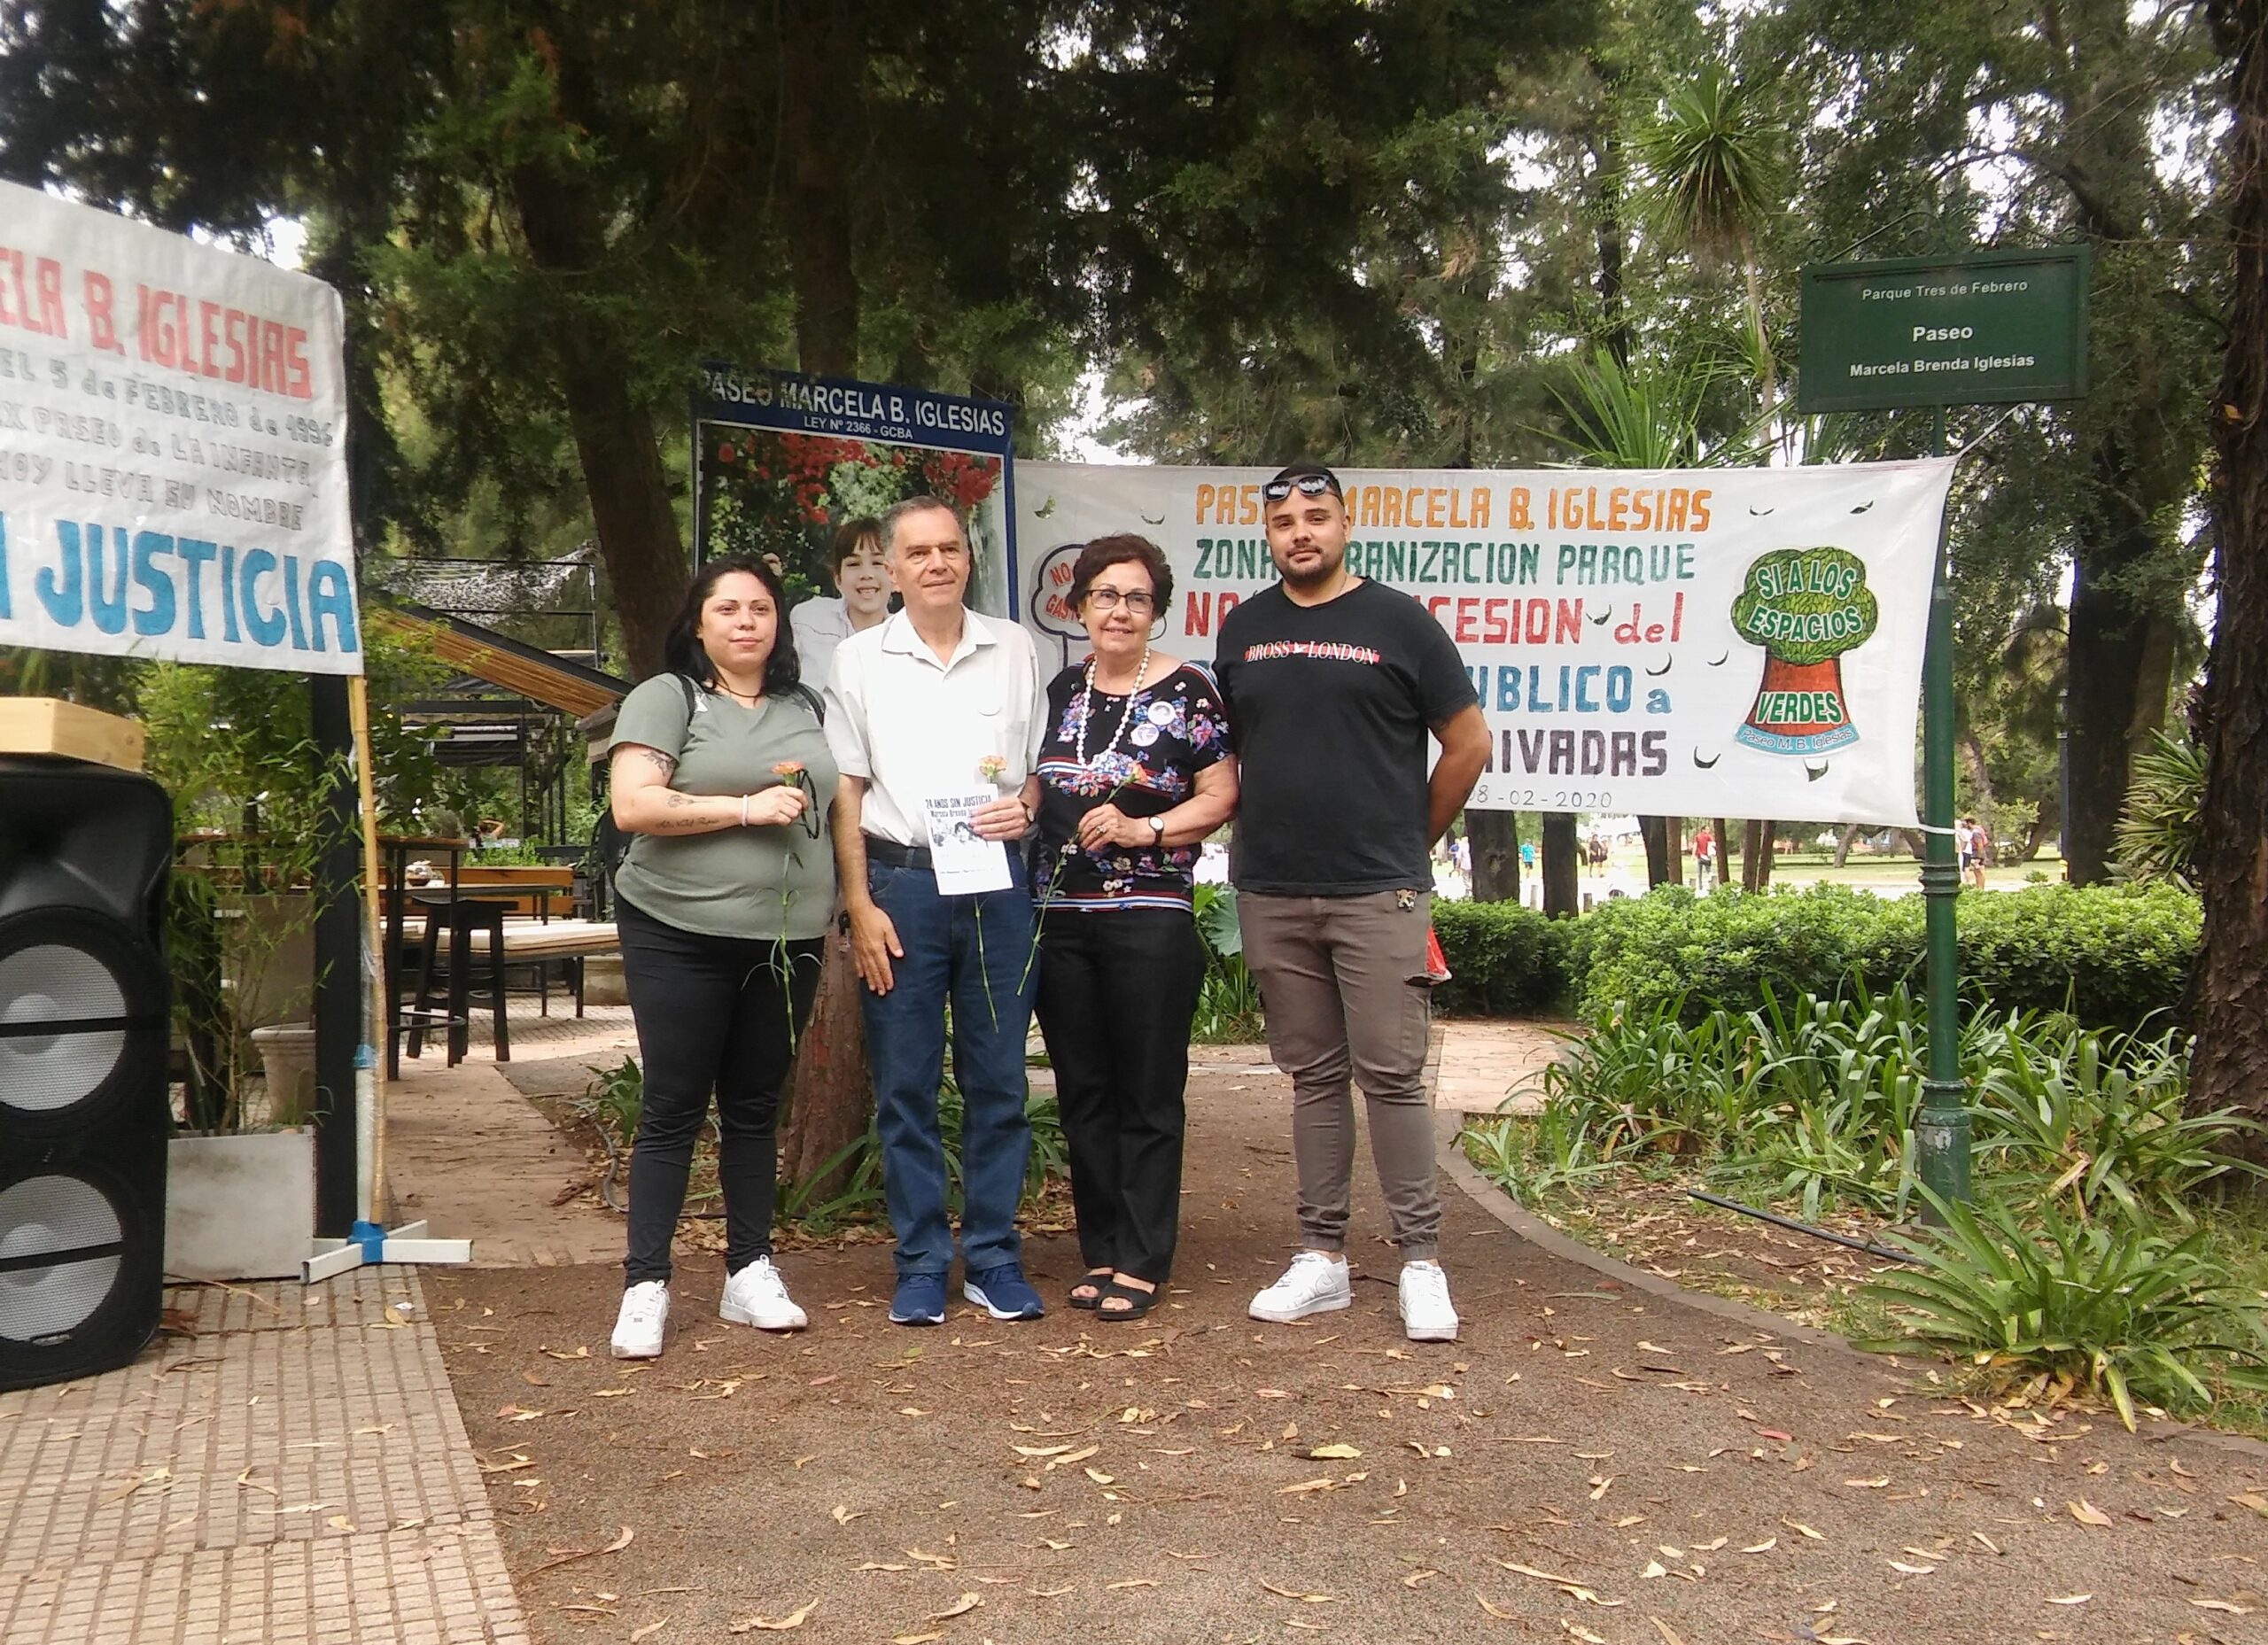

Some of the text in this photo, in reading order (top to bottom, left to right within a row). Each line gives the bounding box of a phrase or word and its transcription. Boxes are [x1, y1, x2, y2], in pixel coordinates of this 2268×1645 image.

[1862, 280, 2028, 301] Parque Tres de Febrero
[138, 283, 313, 400] IGLESIAS
[1912, 326, 1974, 342] Paseo
[1850, 353, 2035, 377] Marcela Brenda Iglesias
[123, 377, 238, 428] FEBRERO
[780, 382, 885, 421] MARCELA
[890, 396, 910, 424] B.
[915, 400, 1005, 437] IGLESIAS
[32, 407, 121, 448] PASEO
[804, 416, 827, 429] LEY
[846, 422, 871, 434] 2366
[880, 427, 913, 439] GCBA
[207, 488, 303, 531] NOMBRE
[1195, 484, 1265, 525] PAS
[1509, 487, 1535, 530] B.
[1548, 486, 1712, 532] IGLESIAS
[1050, 563, 1072, 587] NO
[1557, 543, 1695, 586] PARQUE
[1756, 560, 1857, 600] SI A LOS
[34, 520, 357, 653] JUSTICIA
[1614, 592, 1683, 645] del
[1747, 604, 1863, 642] ESPACIOS
[1246, 640, 1378, 665] BROSS LONDON
[1465, 664, 1673, 714] UBLICO a
[1755, 691, 1844, 725] VERDES
[1483, 729, 1667, 777] IVADAS
[1741, 730, 1775, 746] Paseo
[1812, 729, 1852, 749] Iglesias
[963, 795, 991, 808] JUSTICIA
